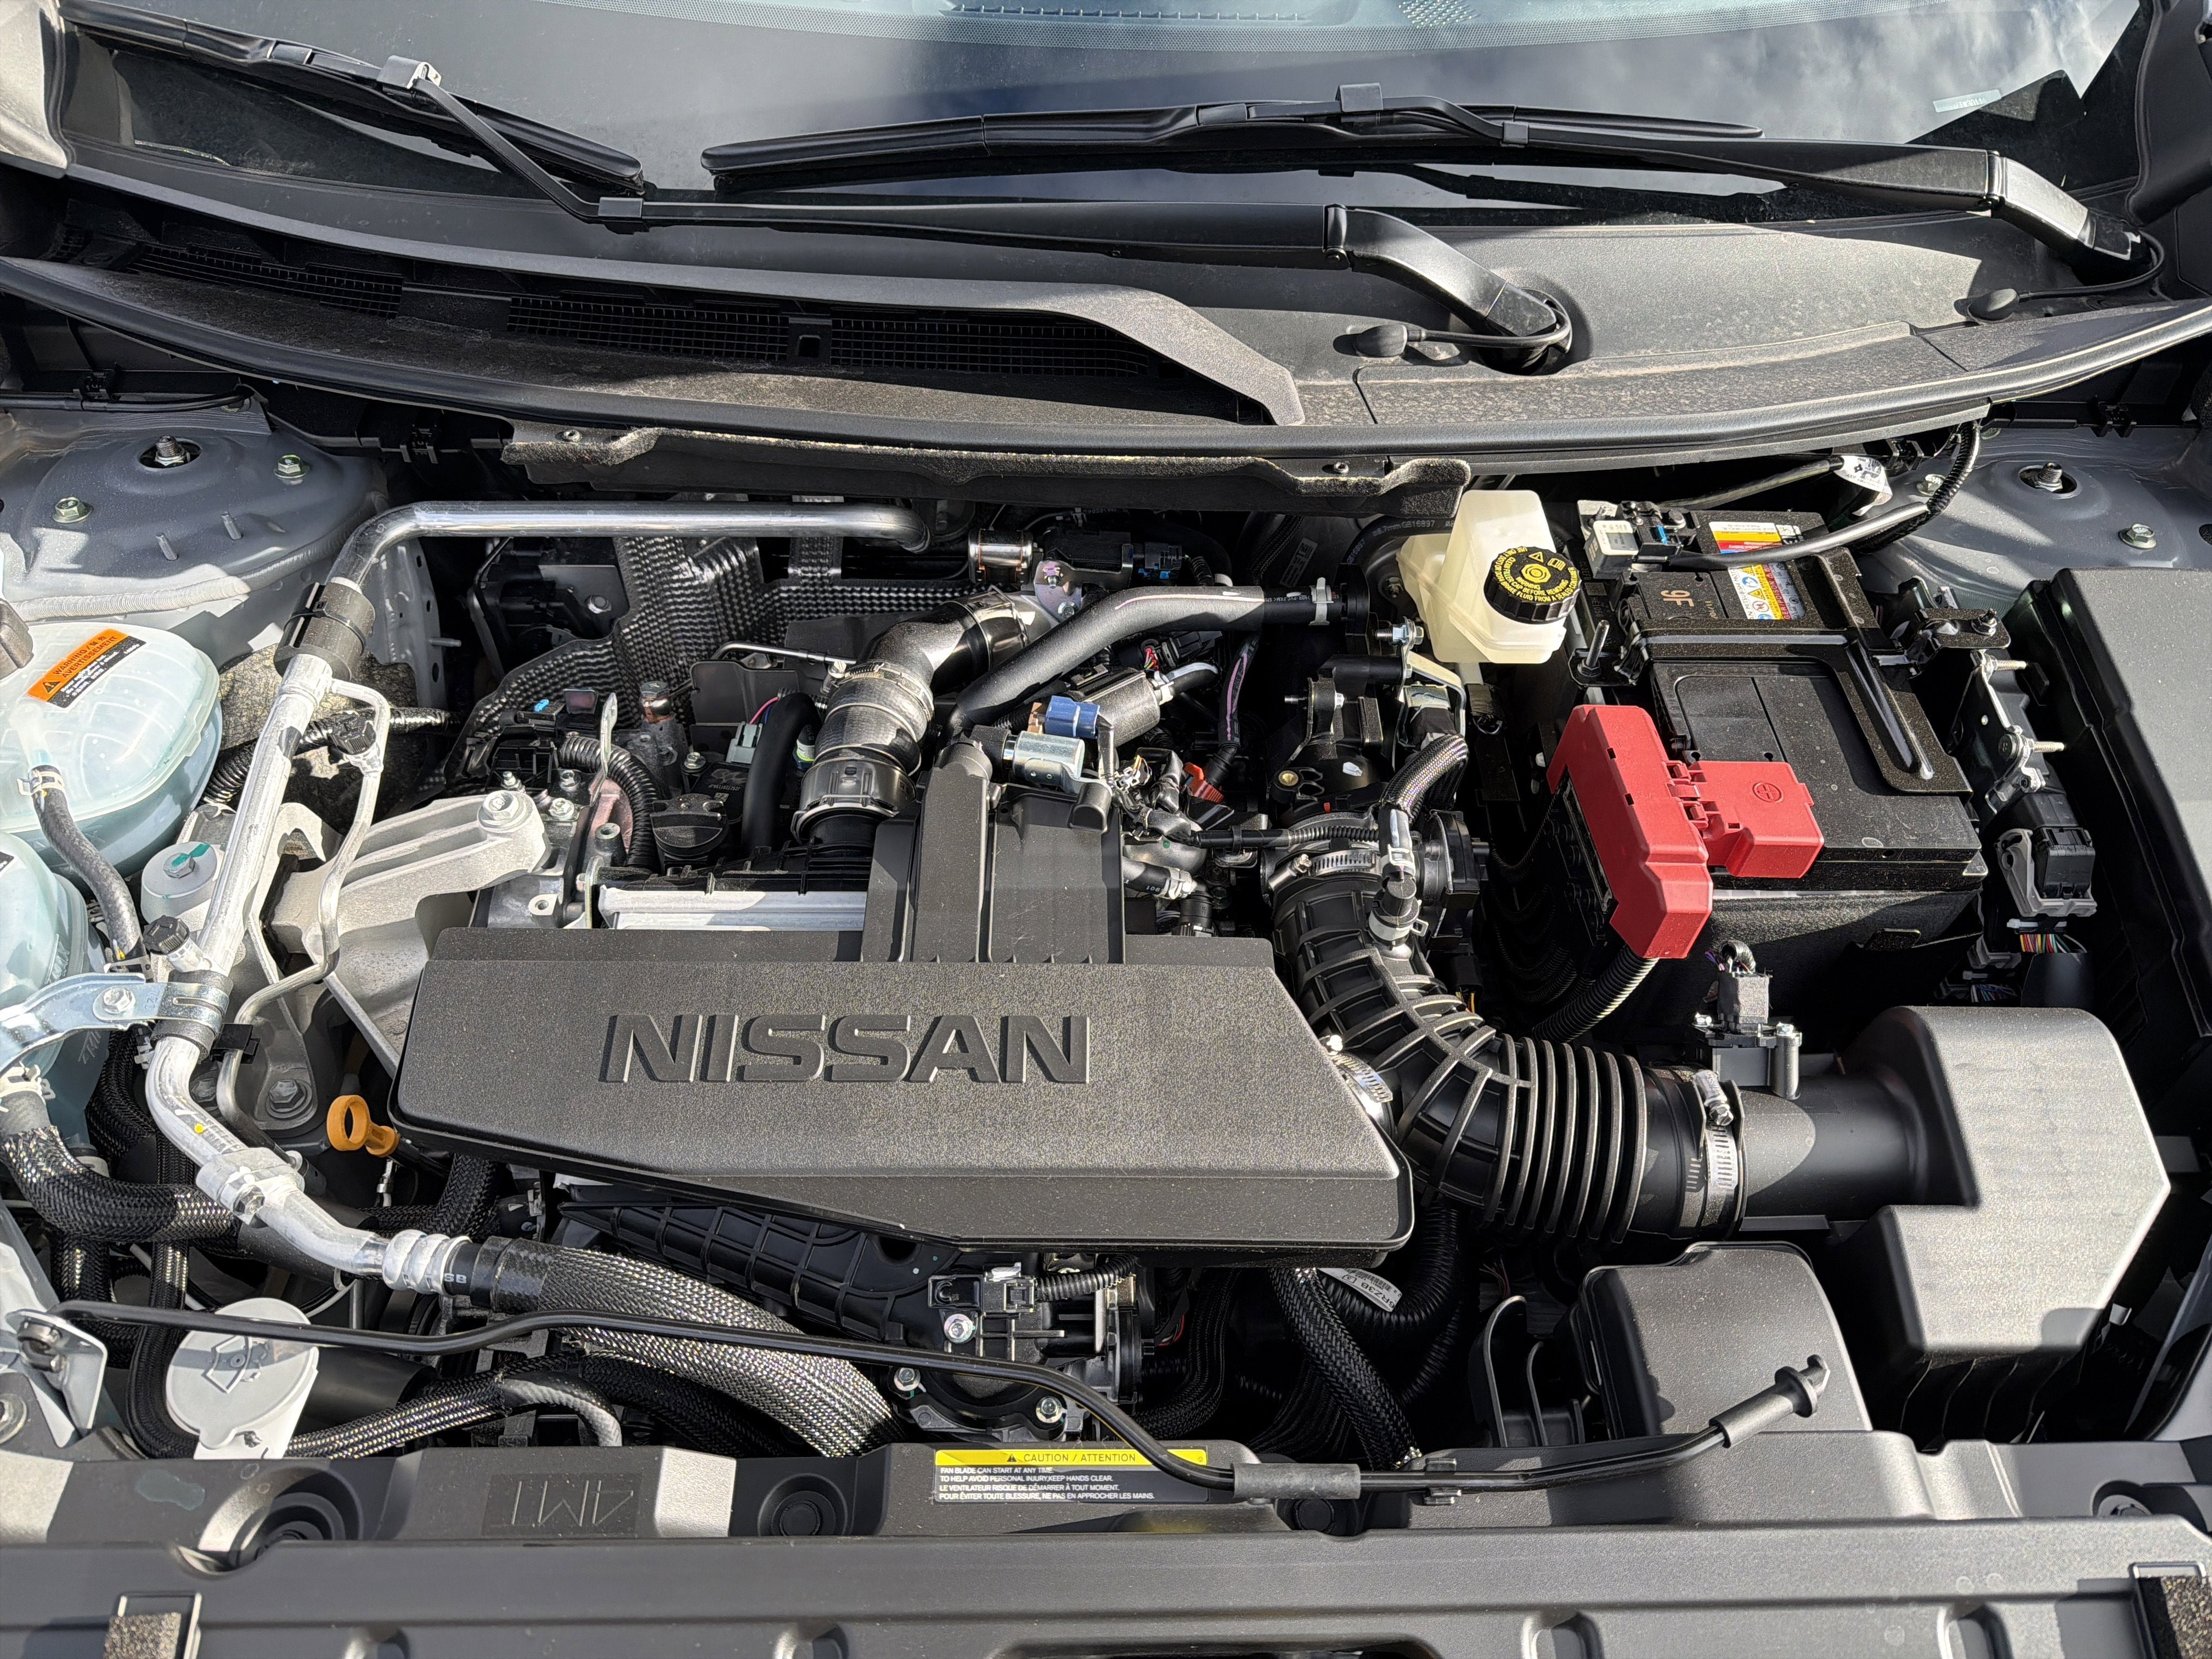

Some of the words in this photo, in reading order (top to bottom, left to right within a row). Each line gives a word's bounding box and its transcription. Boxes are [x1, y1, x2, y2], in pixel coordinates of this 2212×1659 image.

[1501, 581, 1517, 594] BRAKE
[1516, 591, 1533, 601] FLUID
[1556, 588, 1573, 600] SEALED
[1503, 569, 1515, 584] FILLER
[1511, 581, 1523, 590] CAP
[1522, 588, 1547, 596] BEFORE
[1546, 579, 1568, 595] REMOVING
[1515, 576, 1541, 590] WARNING
[1661, 590, 1694, 607] 9F
[53, 648, 88, 675] WARNING
[62, 636, 117, 678] AVERTISSEMENT
[598, 1014, 1090, 1083] NISSAN
[444, 1273, 467, 1284] SB
[1023, 1453, 1069, 1462] CAUTION
[1080, 1453, 1136, 1462] ATTENTION
